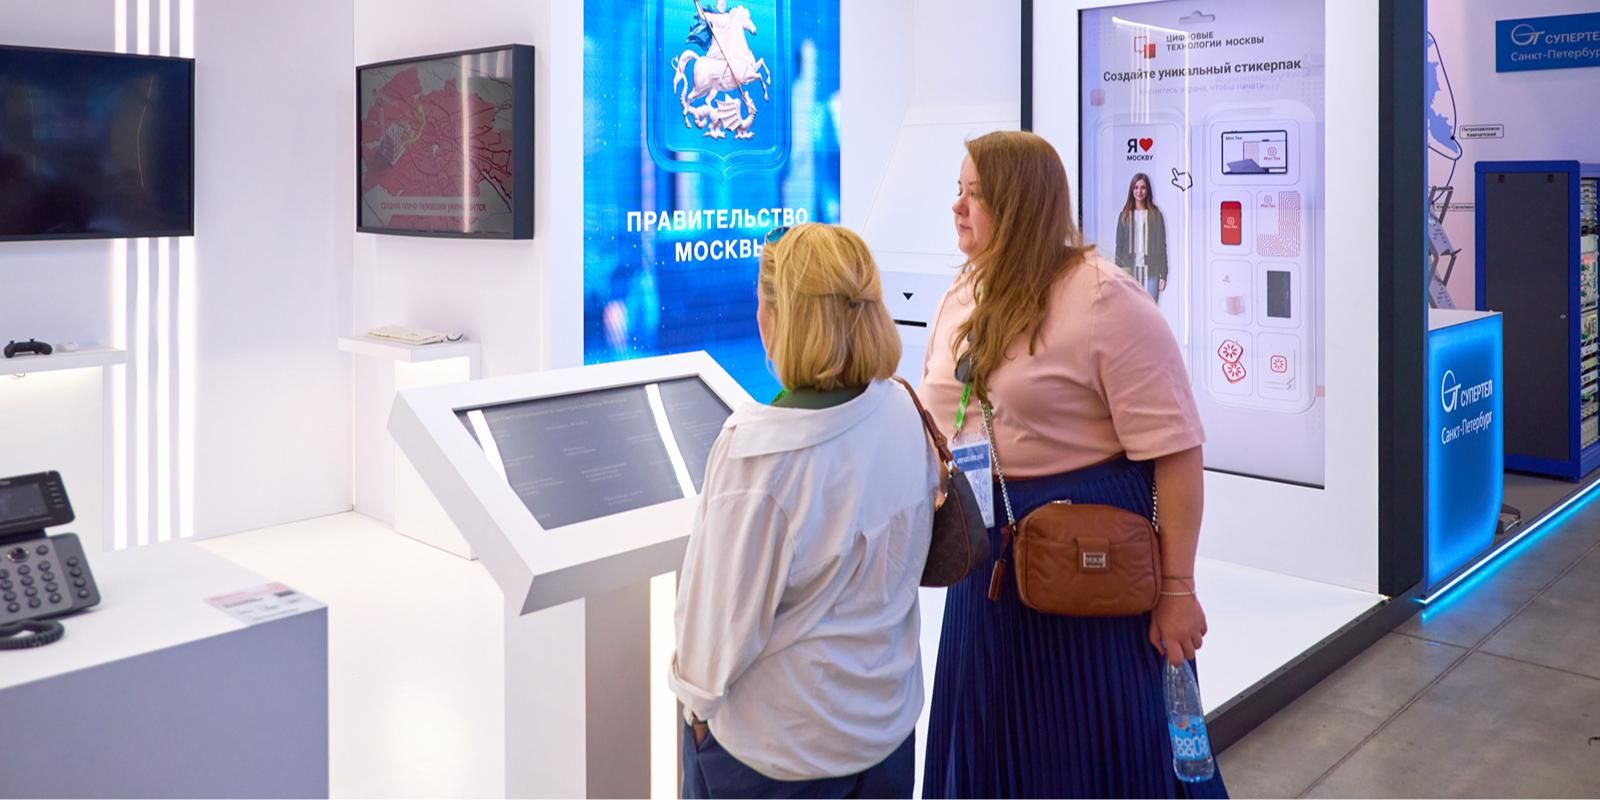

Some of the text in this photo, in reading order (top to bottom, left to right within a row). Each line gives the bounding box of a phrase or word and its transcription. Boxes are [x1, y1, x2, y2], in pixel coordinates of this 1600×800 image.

[1166, 31, 1214, 43] ЦИФОВЫЕ
[1225, 36, 1265, 47] МОСКВЫ
[1103, 68, 1156, 82] Создайте
[1158, 62, 1232, 80] уникальный
[1234, 59, 1302, 75] стикерпак
[1127, 138, 1138, 154] Я
[1126, 154, 1154, 162] МОСКВУ
[627, 208, 808, 233] ПРАВИТЕЛЬСТВО
[1460, 379, 1493, 407] СУПЕРТЕЛ
[1441, 410, 1493, 445] Санкт-Петербург
